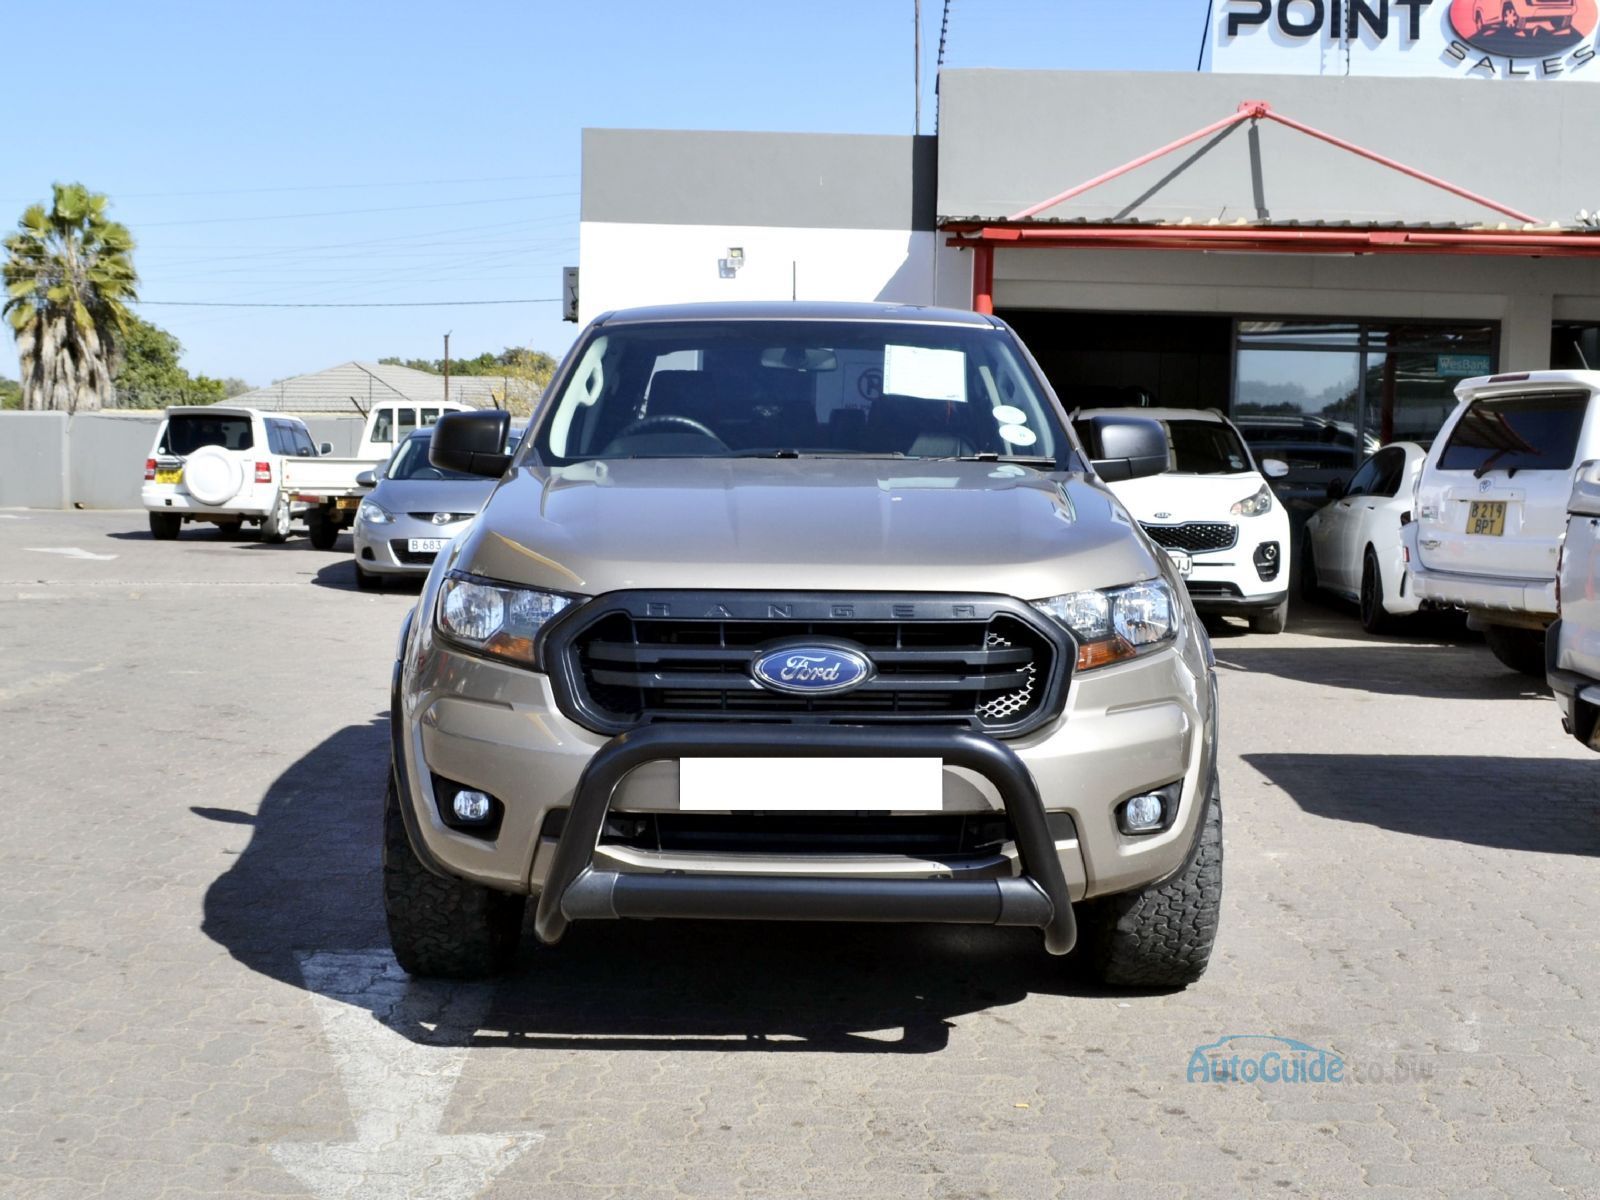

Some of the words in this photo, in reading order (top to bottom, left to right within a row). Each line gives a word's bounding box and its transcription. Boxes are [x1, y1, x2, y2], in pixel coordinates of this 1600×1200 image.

[1227, 0, 1434, 40] POINT
[1445, 40, 1596, 75] SALES
[1439, 357, 1490, 370] WesBank
[411, 540, 419, 550] B
[646, 603, 976, 617] RANGER
[781, 655, 840, 681] Ford
